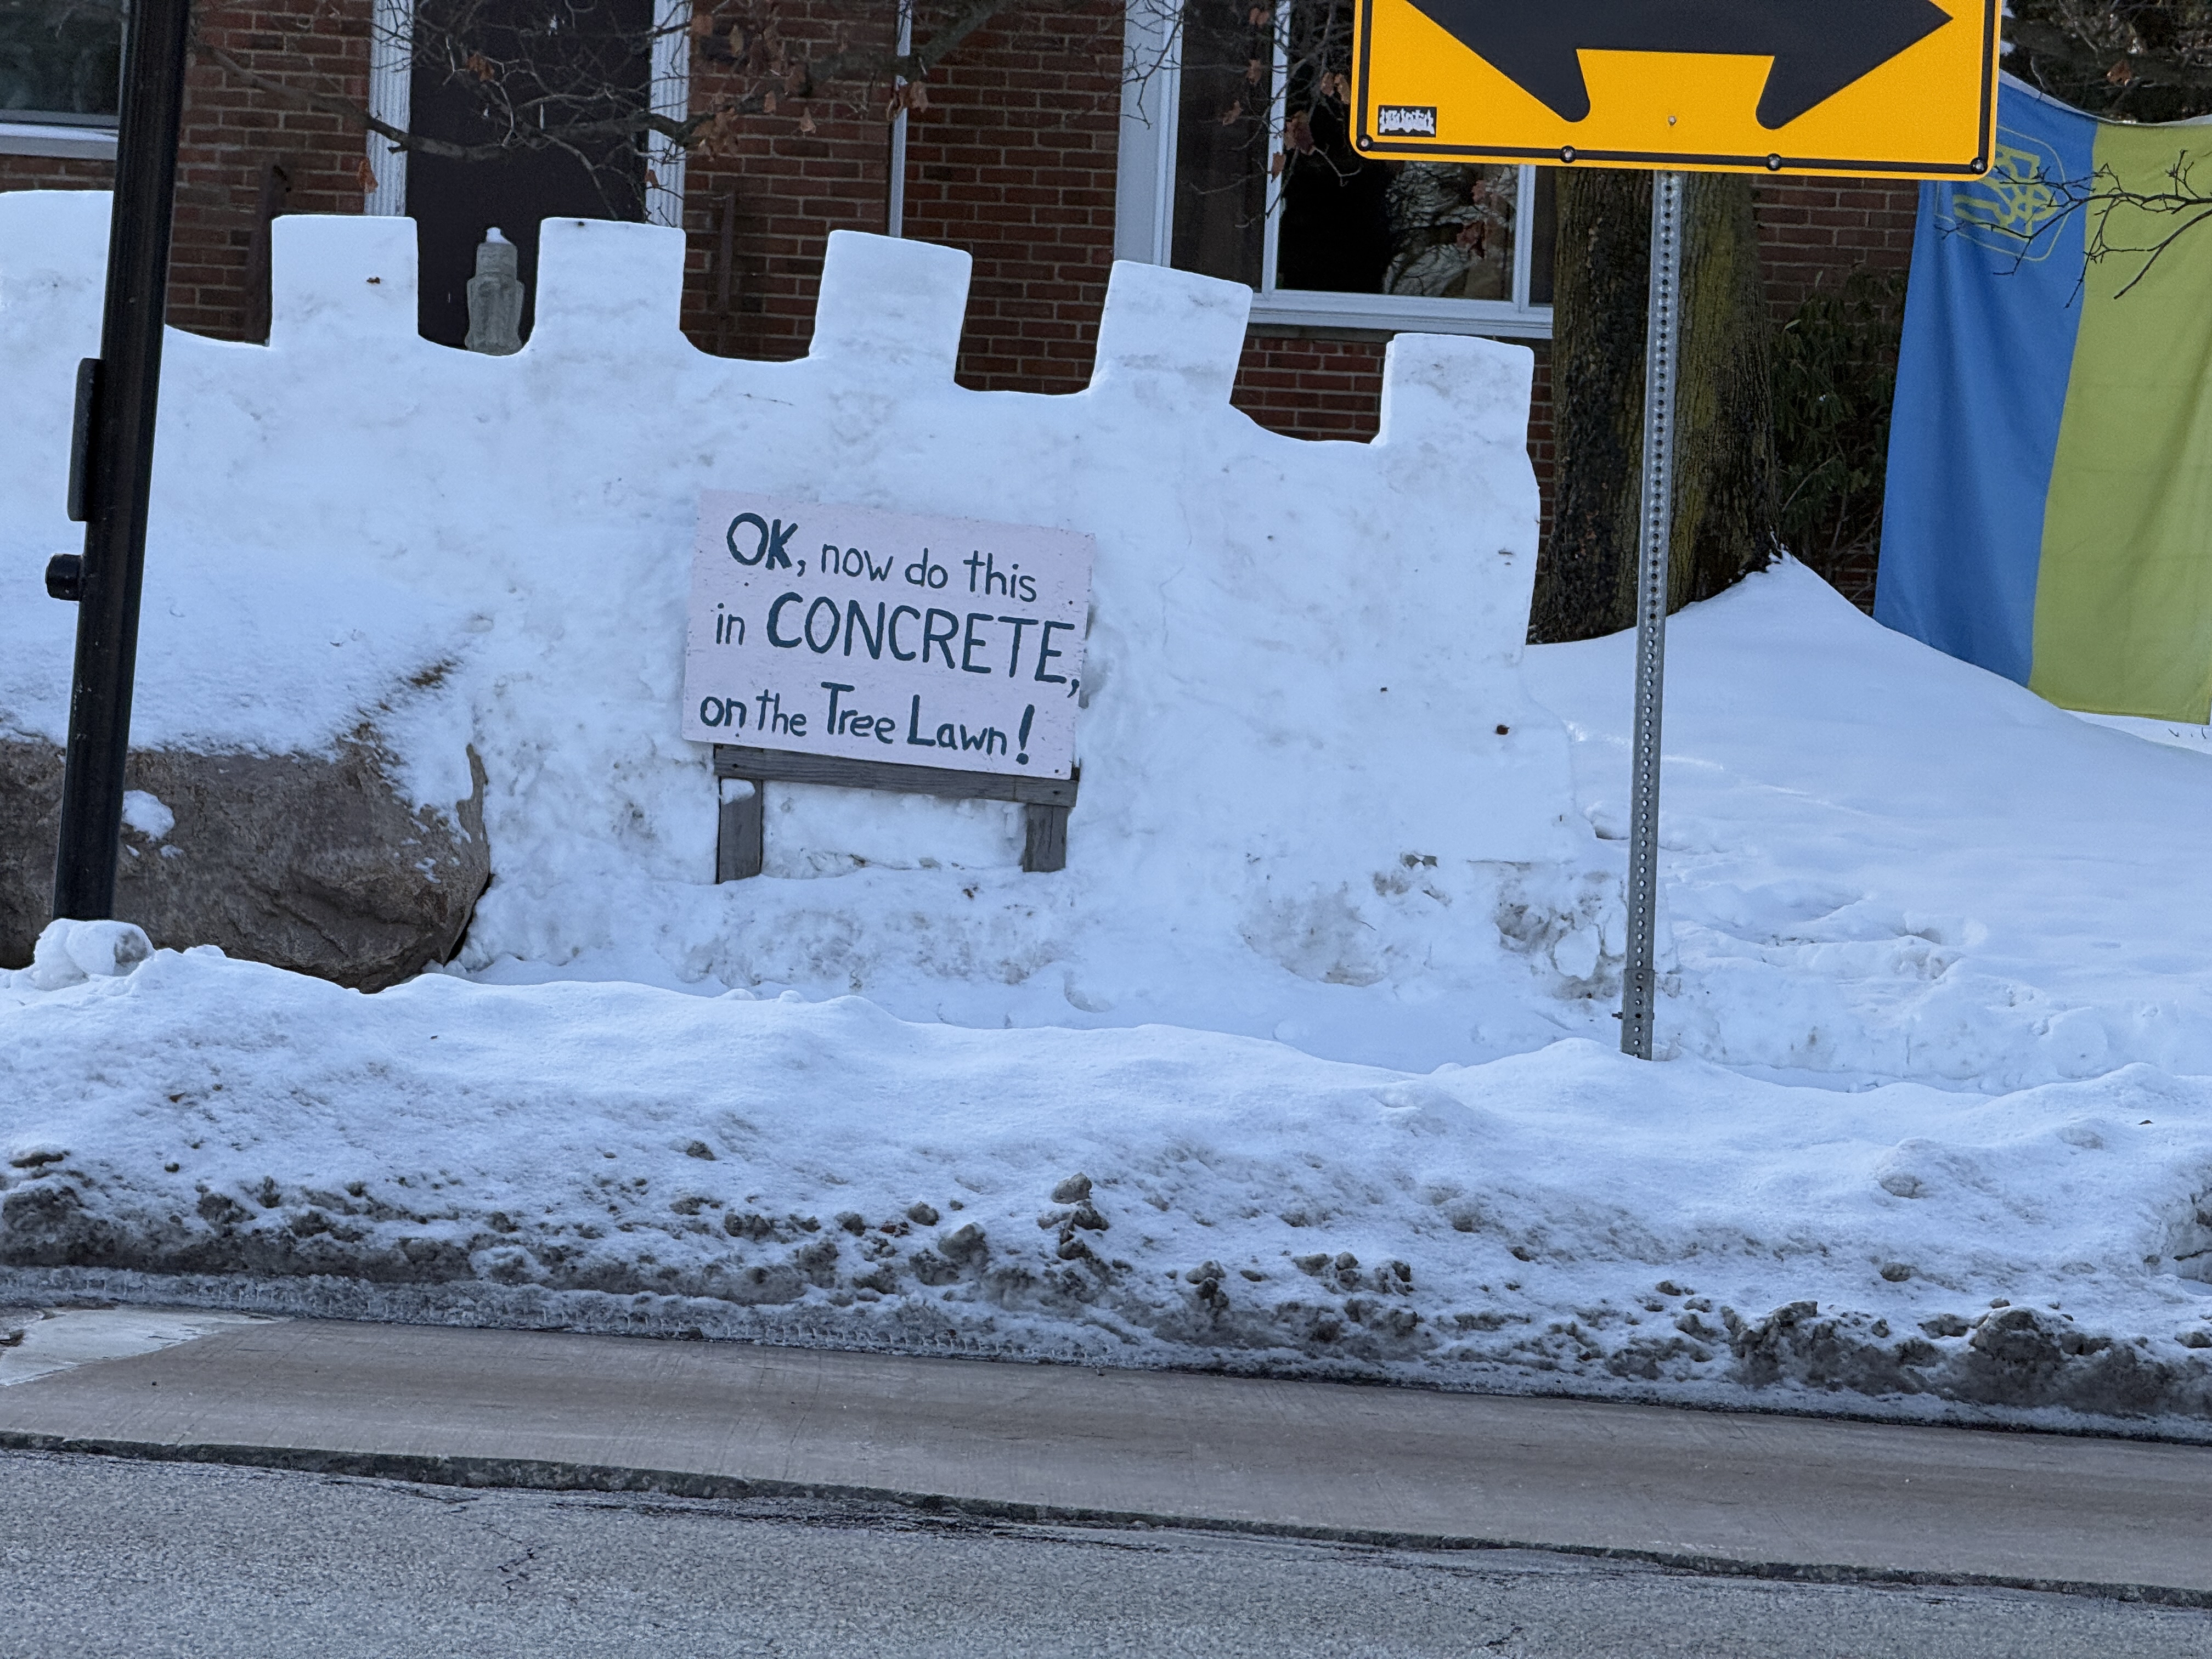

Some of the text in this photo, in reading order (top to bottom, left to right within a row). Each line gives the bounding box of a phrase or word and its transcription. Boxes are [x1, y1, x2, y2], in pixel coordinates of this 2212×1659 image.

[726, 512, 1037, 603] OK, now do this
[716, 591, 1080, 698] in CONCRETE,
[699, 681, 1035, 765] on the Tree Lawn!
